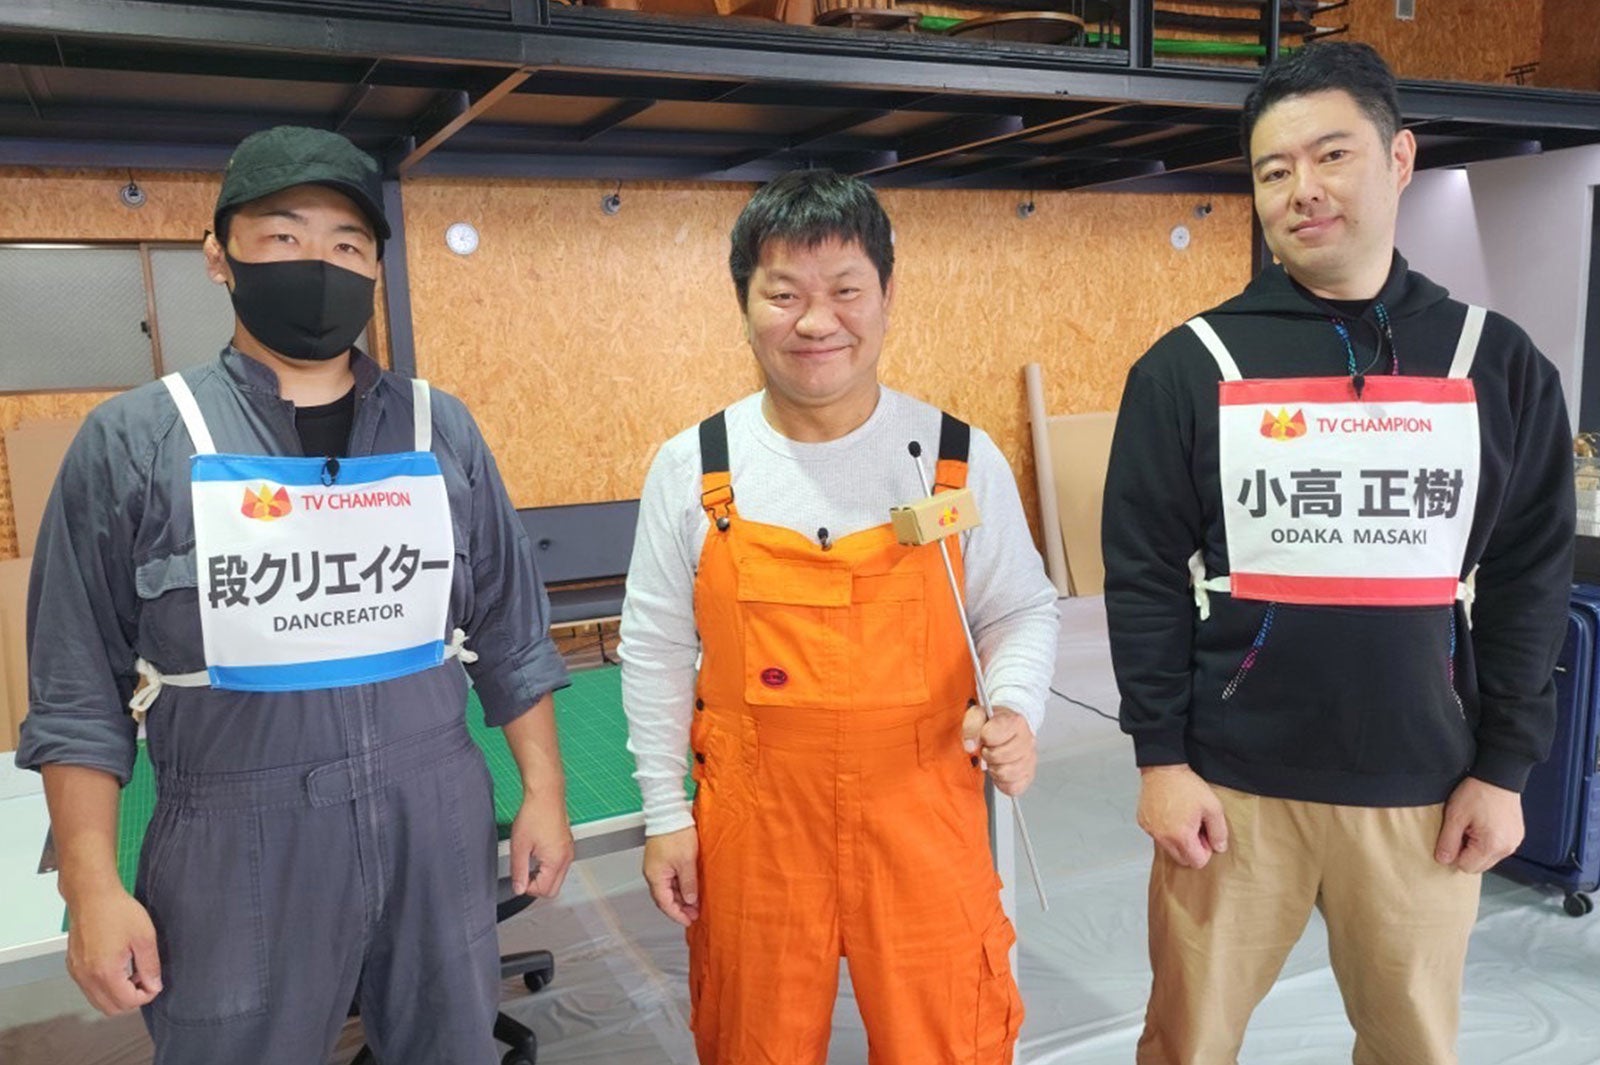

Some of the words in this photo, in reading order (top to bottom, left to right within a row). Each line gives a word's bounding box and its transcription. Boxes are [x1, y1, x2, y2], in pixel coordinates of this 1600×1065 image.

[1316, 418, 1338, 432] TV
[1341, 417, 1432, 433] CHAMPION
[301, 494, 325, 511] TV
[327, 491, 411, 510] CHAMPION
[1237, 468, 1342, 518] 小高
[1358, 468, 1464, 519] 正樹
[1271, 528, 1343, 544] ODAKA
[1353, 529, 1427, 545] MASAKI
[208, 543, 449, 609] 段クリエイター
[273, 603, 405, 632] DANCREATOR
